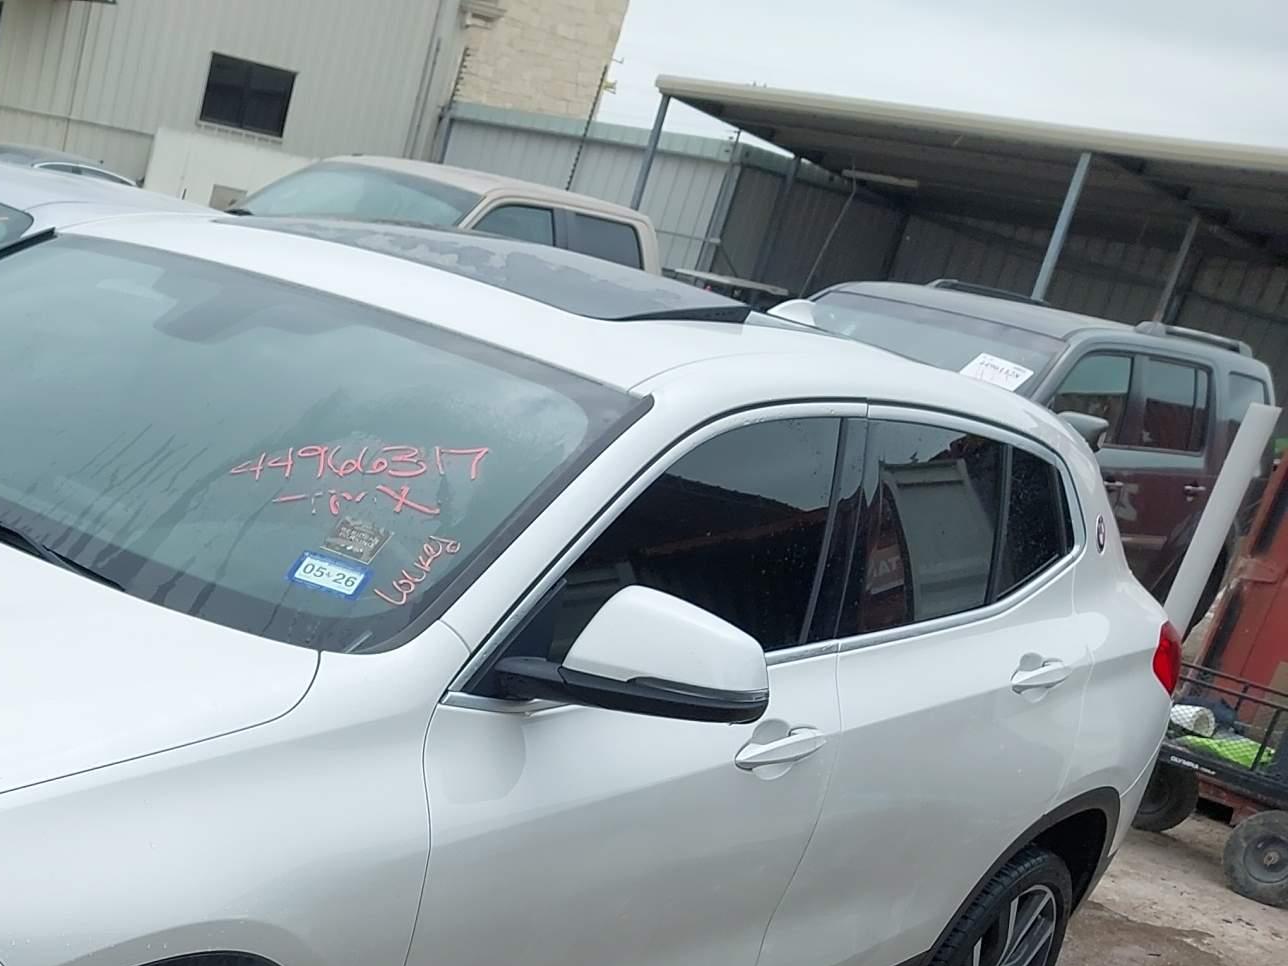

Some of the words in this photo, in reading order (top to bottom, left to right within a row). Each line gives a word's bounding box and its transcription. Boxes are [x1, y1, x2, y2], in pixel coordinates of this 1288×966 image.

[230, 445, 490, 480] 44966317
[302, 563, 327, 578] 05
[333, 572, 358, 588] 26
